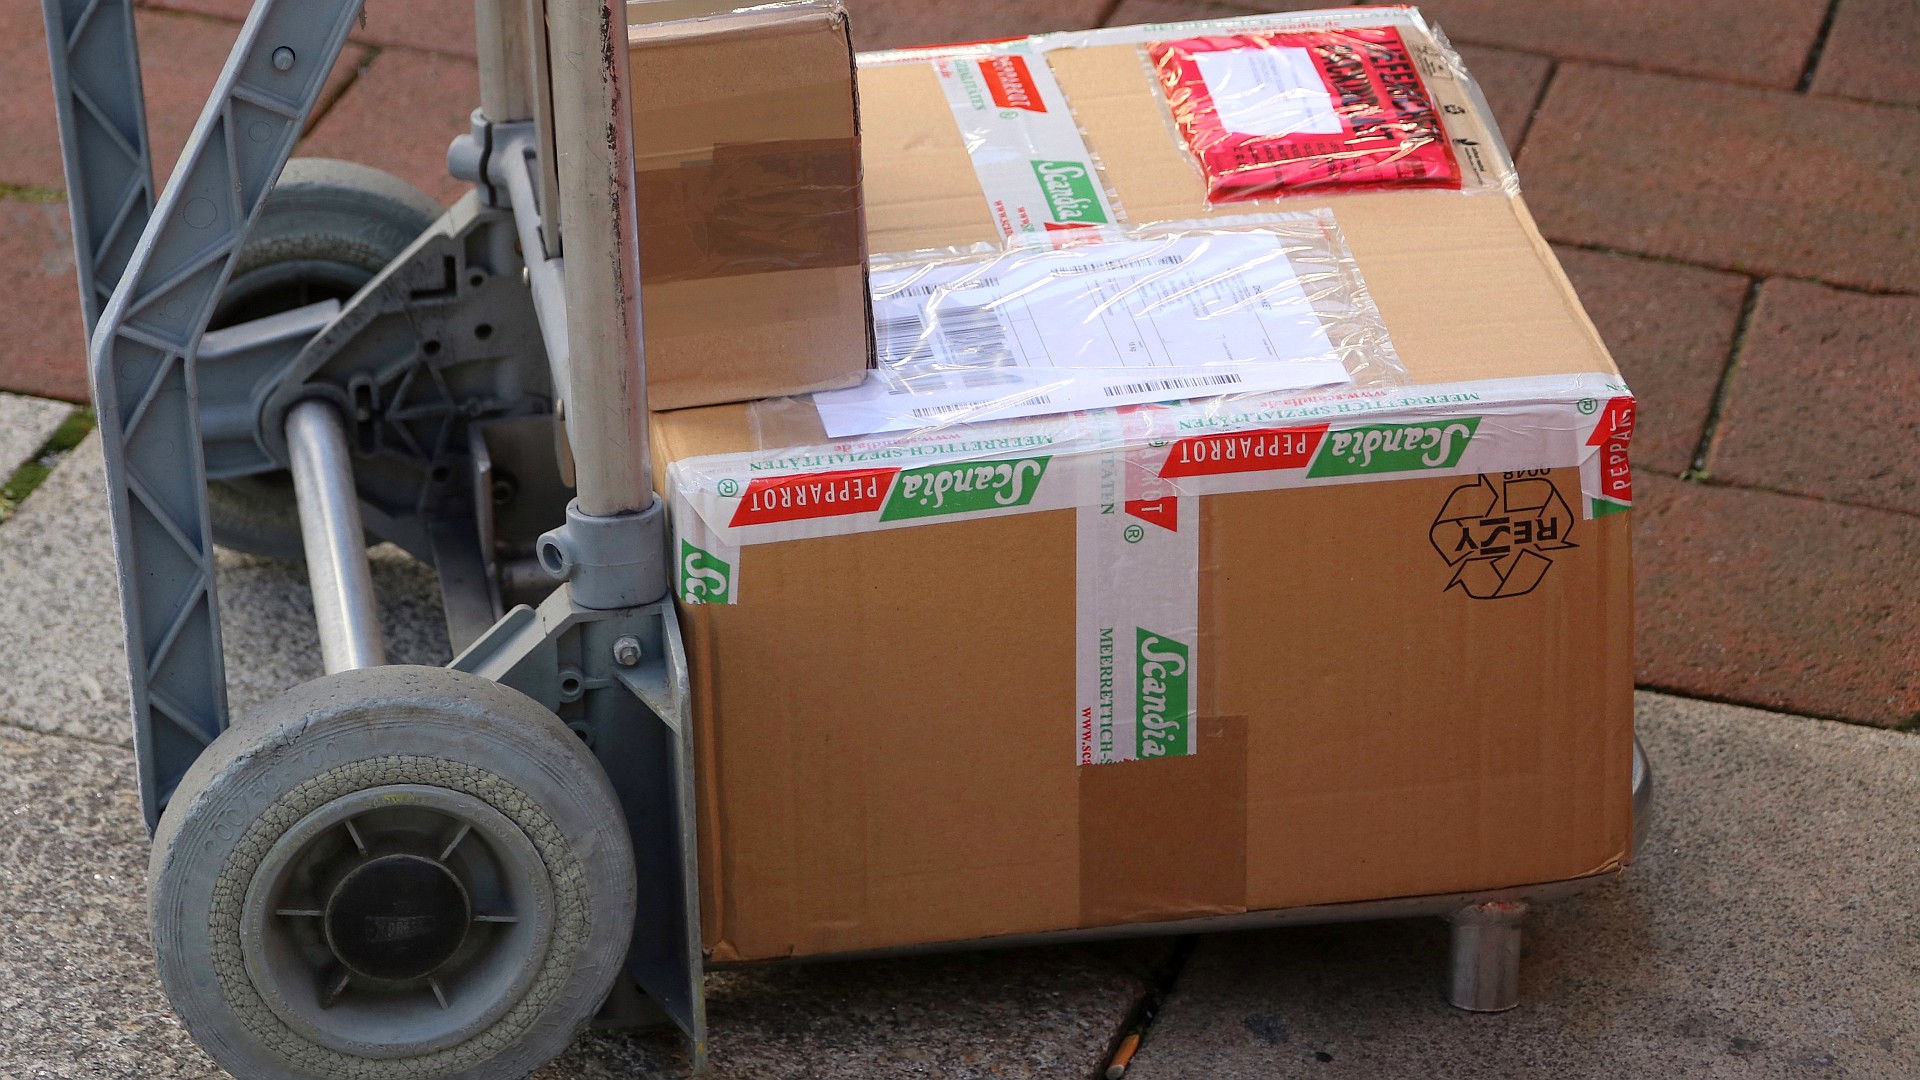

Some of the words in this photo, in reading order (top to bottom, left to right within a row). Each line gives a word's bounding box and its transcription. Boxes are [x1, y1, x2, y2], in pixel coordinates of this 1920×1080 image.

[1038, 161, 1085, 220] Scandia
[1180, 433, 1307, 464] PEPPARROT
[1331, 423, 1470, 468] Scandia
[750, 477, 877, 512] PEPPARROT
[901, 459, 1041, 509] Scandia
[1140, 634, 1186, 758] Scandia
